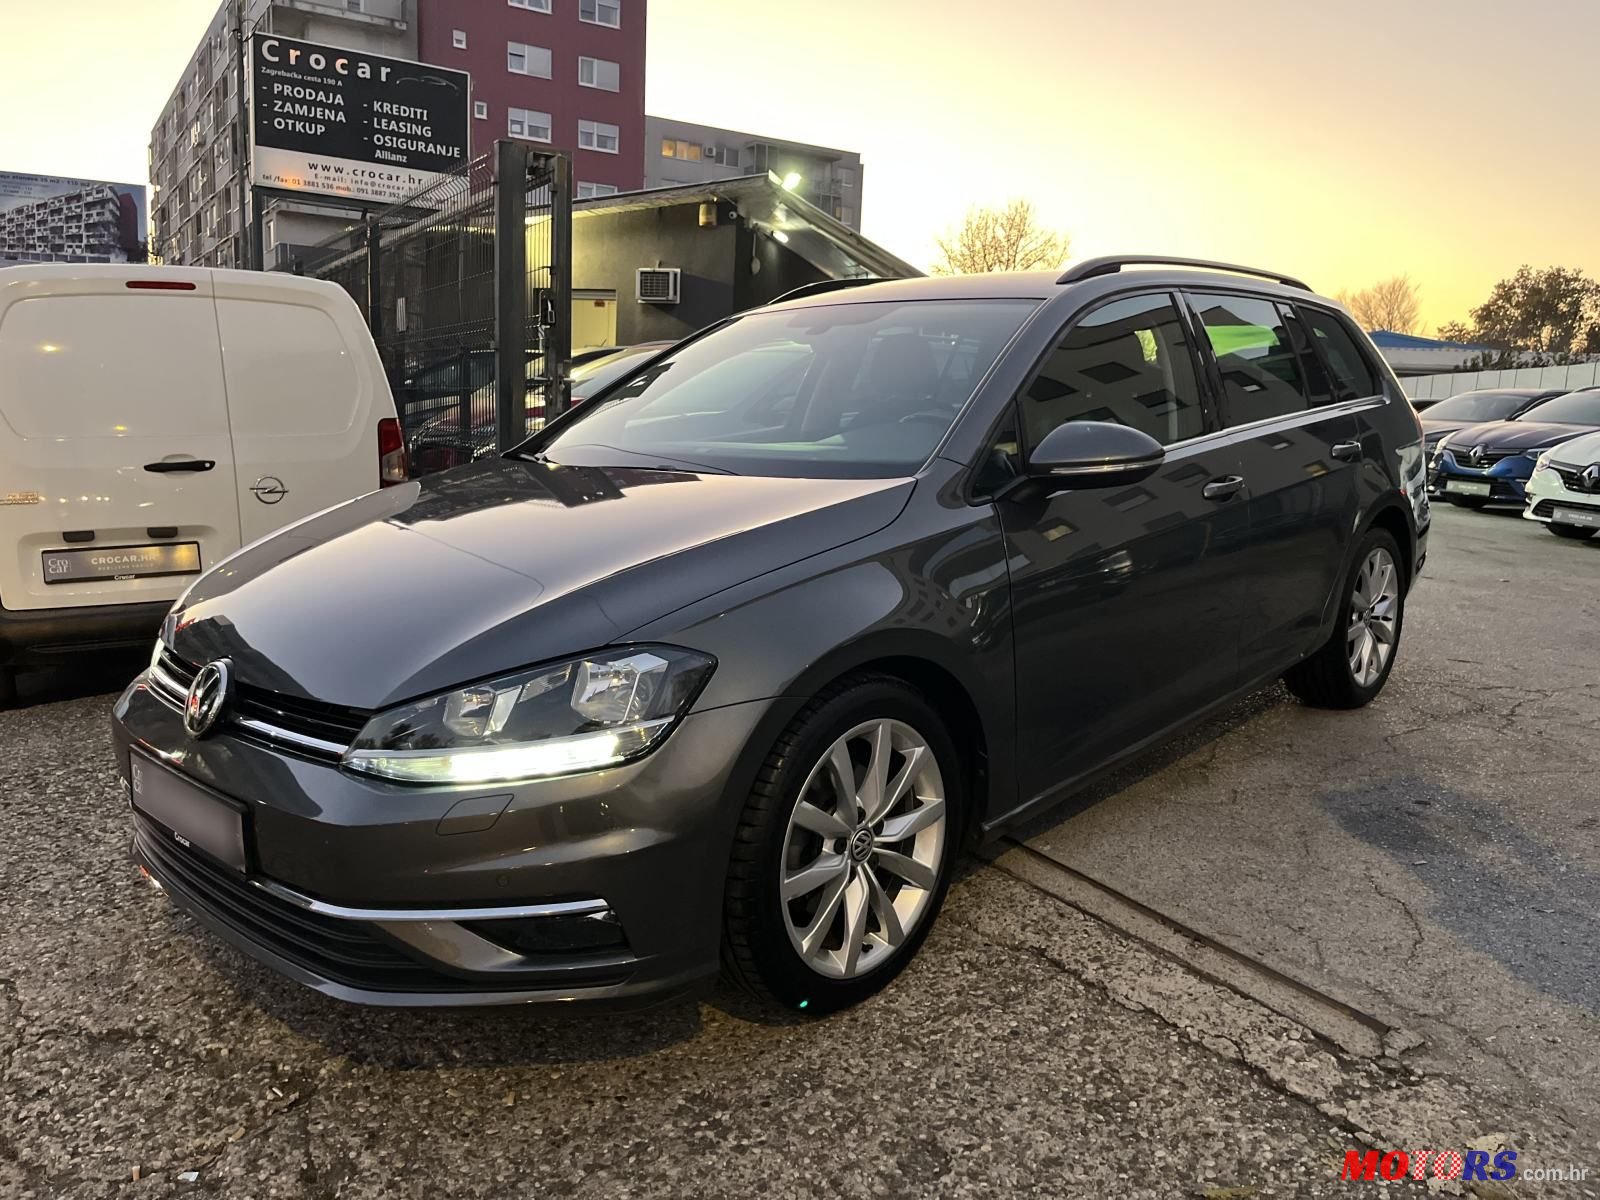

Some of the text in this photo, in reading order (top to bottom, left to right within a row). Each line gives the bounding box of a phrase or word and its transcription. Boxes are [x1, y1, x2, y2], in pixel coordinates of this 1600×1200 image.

[261, 39, 391, 82] Crocar
[303, 75, 322, 83] cesta
[273, 82, 345, 106] PRODAJA
[273, 99, 347, 123] ZAMJENA
[373, 100, 428, 121] KREDITI
[273, 117, 326, 136] OTKUP
[373, 117, 432, 138] LEASING
[373, 134, 461, 158] OSIGURANJE
[374, 149, 408, 163] Allianz
[308, 162, 423, 185] www.crocar.hr
